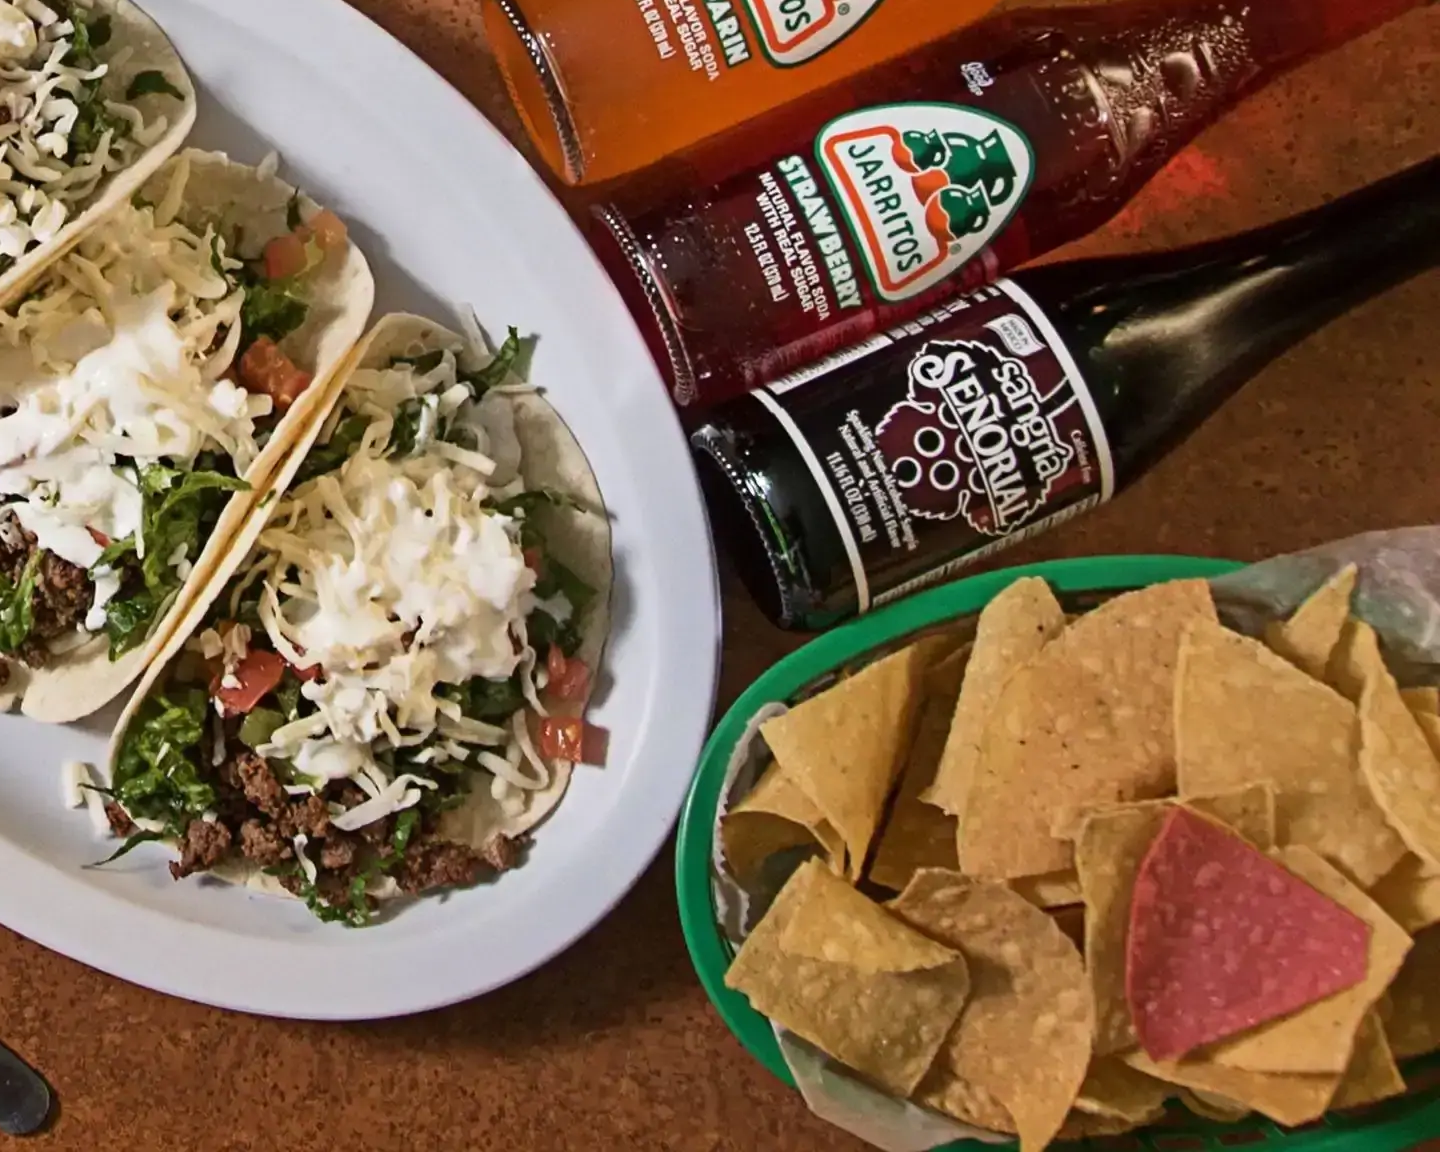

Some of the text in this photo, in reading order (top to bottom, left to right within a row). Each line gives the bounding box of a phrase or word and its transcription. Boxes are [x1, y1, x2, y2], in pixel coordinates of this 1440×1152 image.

[677, 23, 703, 71] SUGAR
[699, 43, 720, 81] SODA
[756, 191, 814, 313] WITH REAL SUGAR
[759, 172, 830, 321] NATURAL FLAVOR SODA
[777, 155, 861, 309] STRAWBERRY
[848, 144, 922, 272] JARRITOS
[838, 424, 867, 461] Natural
[858, 459, 876, 479] and
[868, 478, 895, 521] Artificial
[991, 360, 1067, 481] sangría
[845, 488, 863, 505] OZ
